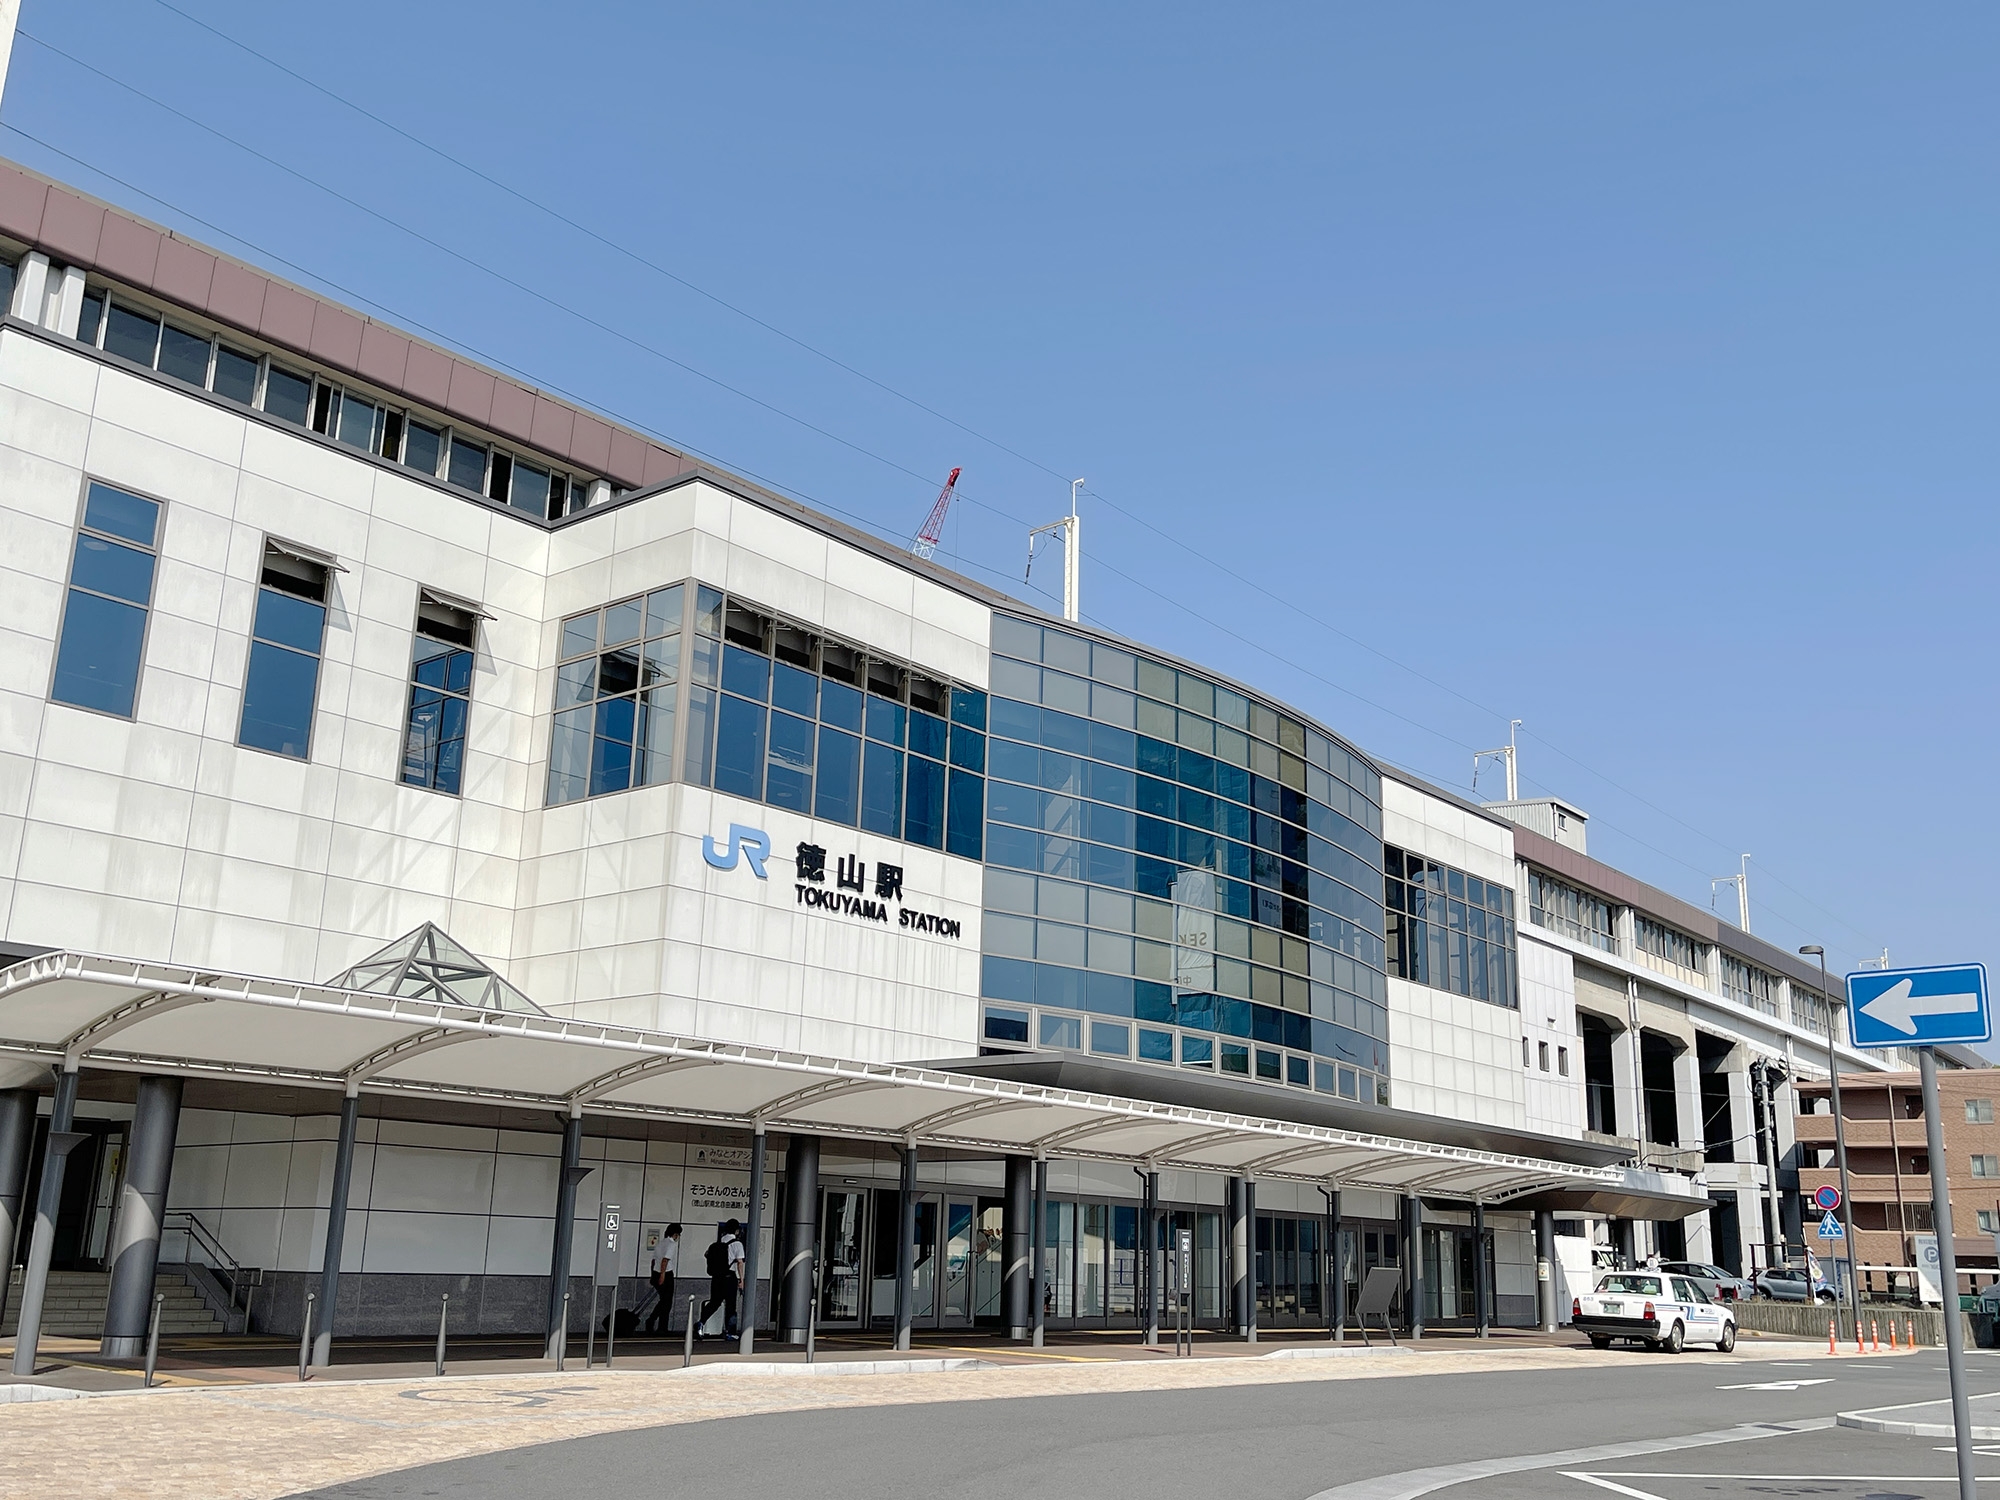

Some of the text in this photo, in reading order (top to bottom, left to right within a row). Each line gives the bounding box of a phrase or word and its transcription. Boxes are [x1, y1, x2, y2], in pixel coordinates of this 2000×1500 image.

[701, 822, 771, 881] JR
[795, 841, 904, 901] 徳山駅
[794, 883, 962, 940] TOKUYAMA STATION
